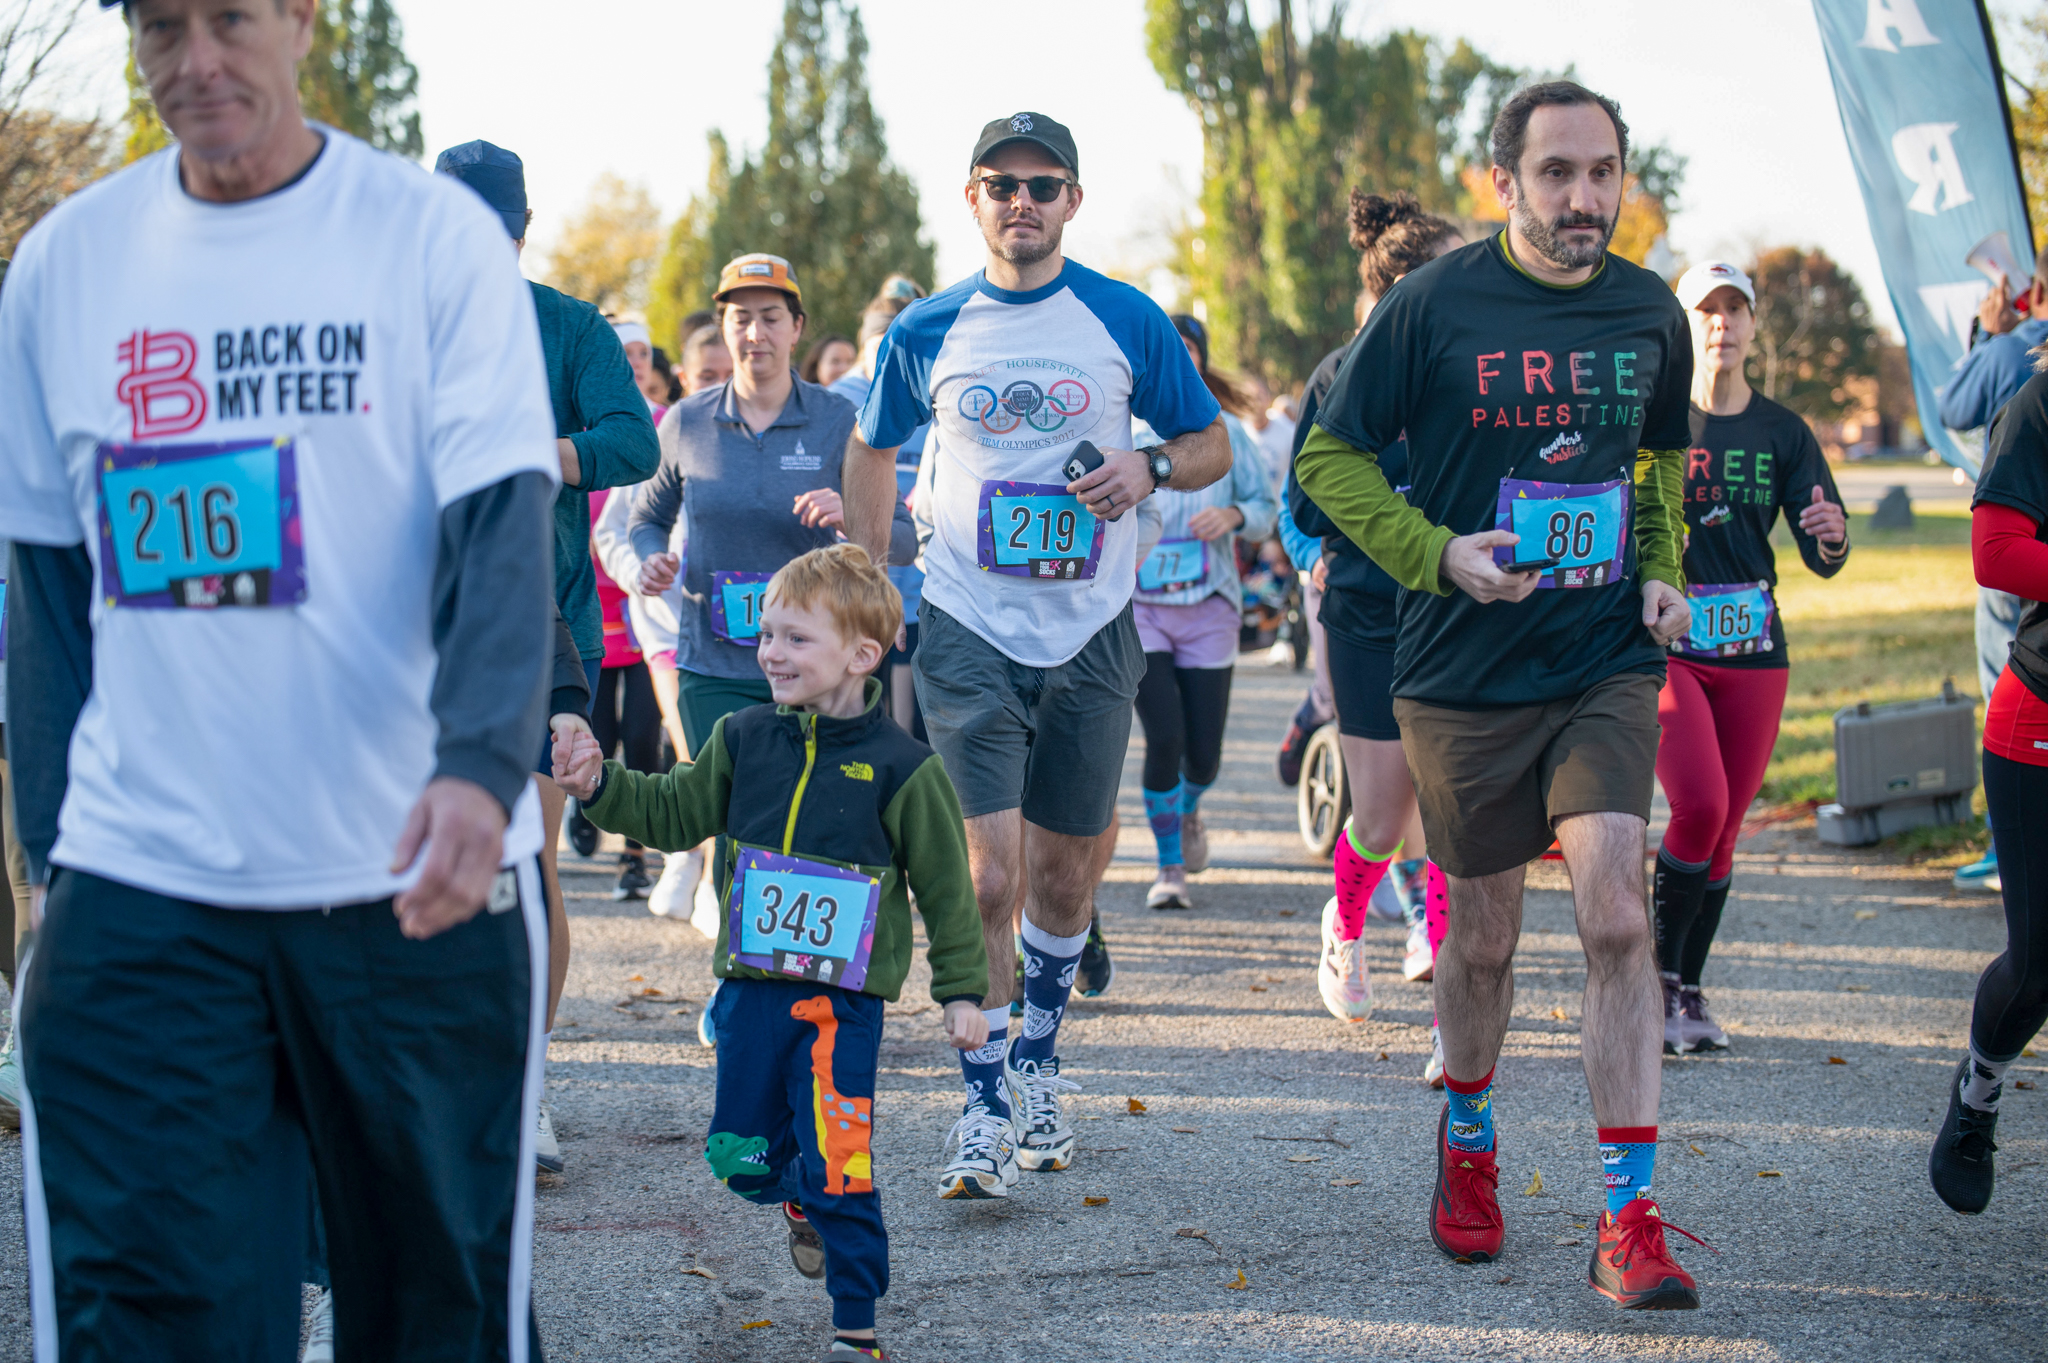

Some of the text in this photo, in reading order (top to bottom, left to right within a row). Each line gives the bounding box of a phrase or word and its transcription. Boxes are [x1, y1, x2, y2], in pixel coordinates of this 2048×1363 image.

[215, 323, 366, 372] BACK ON
[960, 359, 1087, 388] OSLER HOUSESTAFF
[1477, 350, 1639, 397] FREE
[217, 370, 371, 421] MY FEET.
[1472, 403, 1642, 428] PALESTINE
[977, 429, 1076, 449] FIRM OLYMPICS 2017
[1688, 448, 1773, 486] REE
[1682, 485, 1772, 506] LESTINE
[128, 484, 239, 563] 216
[1009, 506, 1077, 553] 219
[1545, 510, 1596, 560] 86
[1155, 552, 1181, 577] 77
[1703, 603, 1751, 638] 165
[840, 764, 864, 775] NORTH
[852, 761, 865, 769] THE
[756, 883, 839, 948] 343
[1451, 1121, 1485, 1136] POW!
